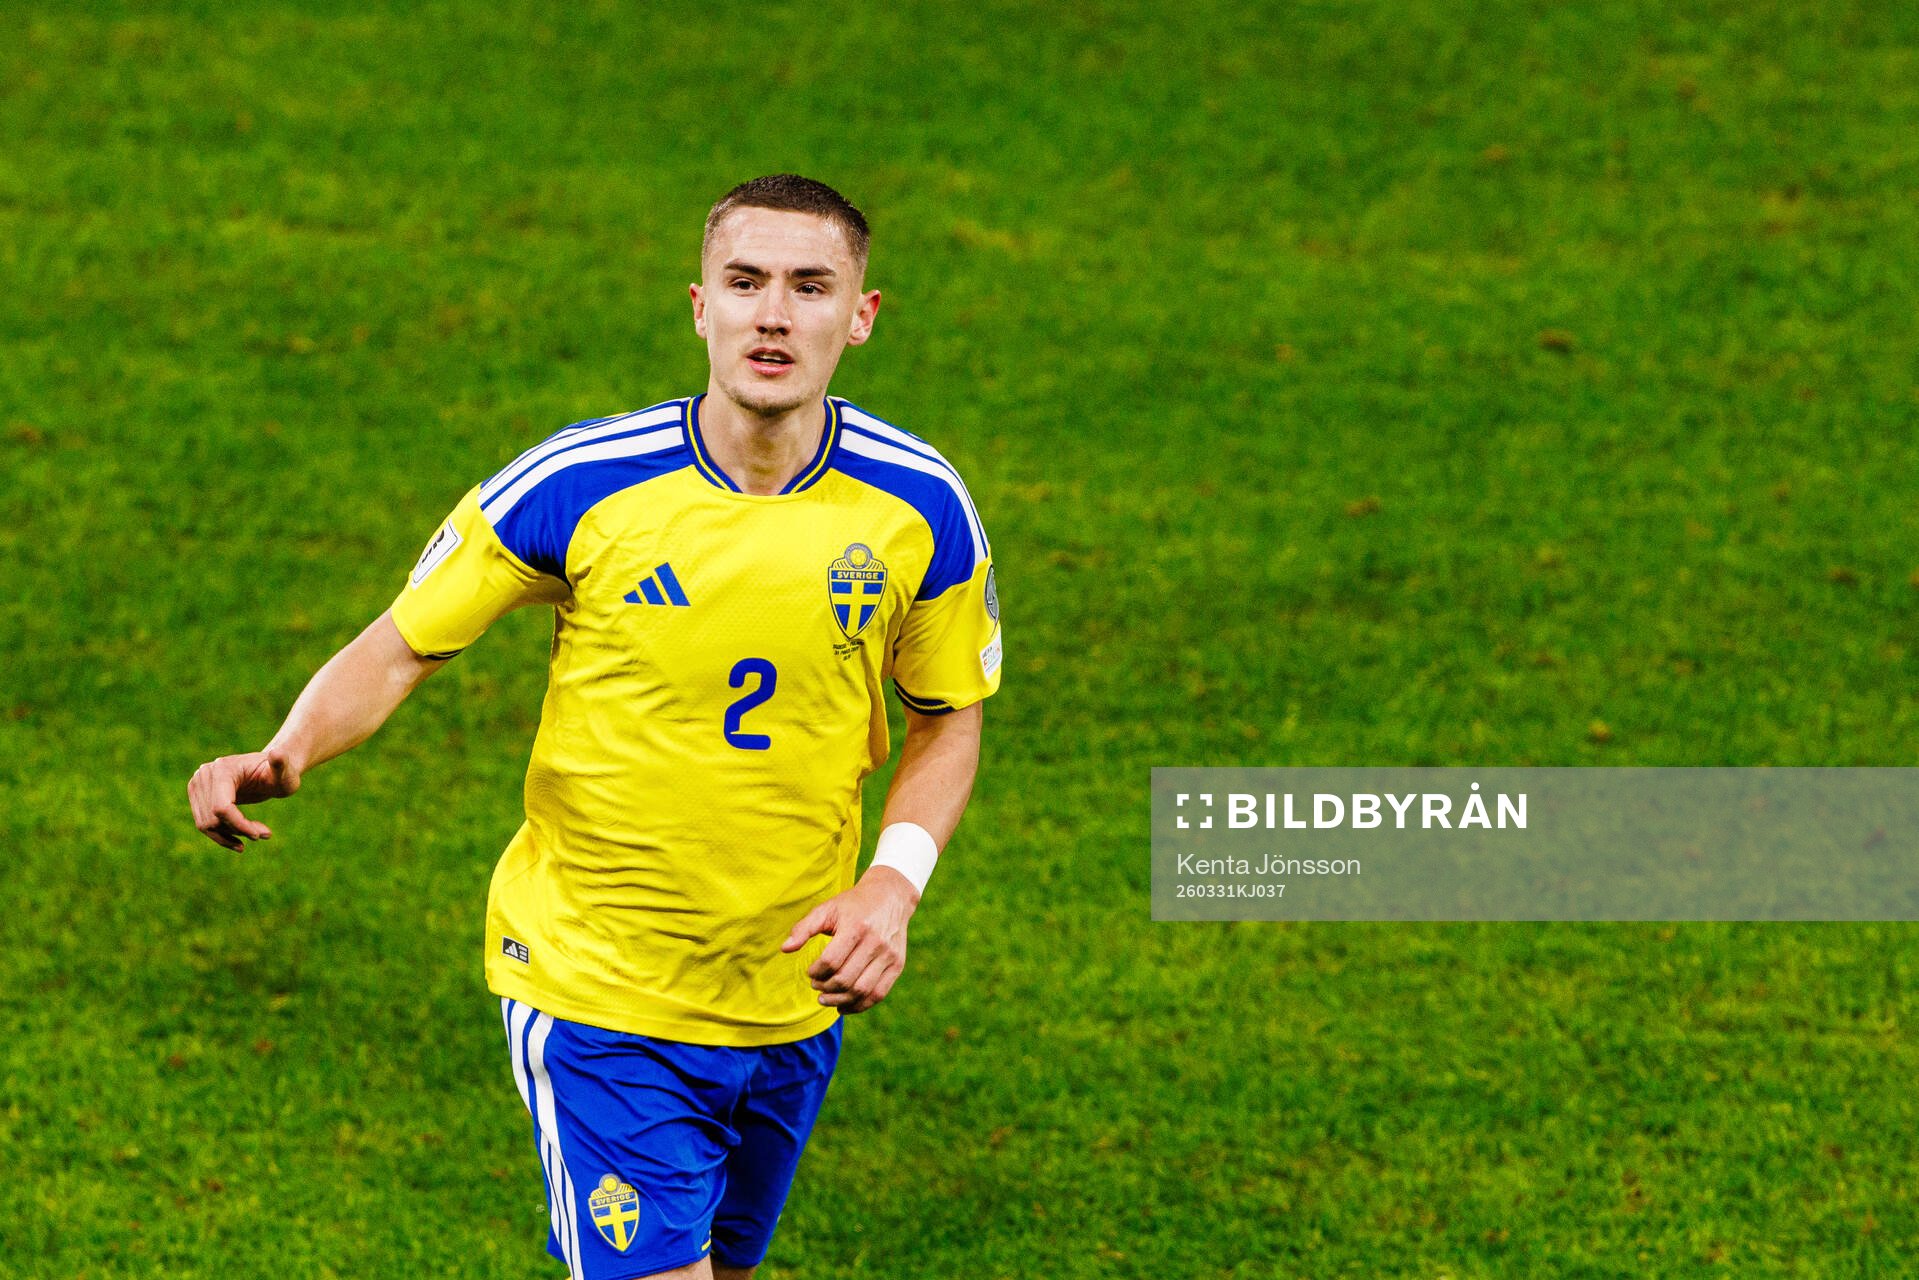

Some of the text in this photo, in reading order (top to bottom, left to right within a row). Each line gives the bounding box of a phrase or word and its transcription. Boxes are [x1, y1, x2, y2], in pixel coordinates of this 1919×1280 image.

[837, 571, 879, 580] SVERIGE
[723, 657, 778, 750] 2
[595, 1193, 630, 1205] SVERIGE
